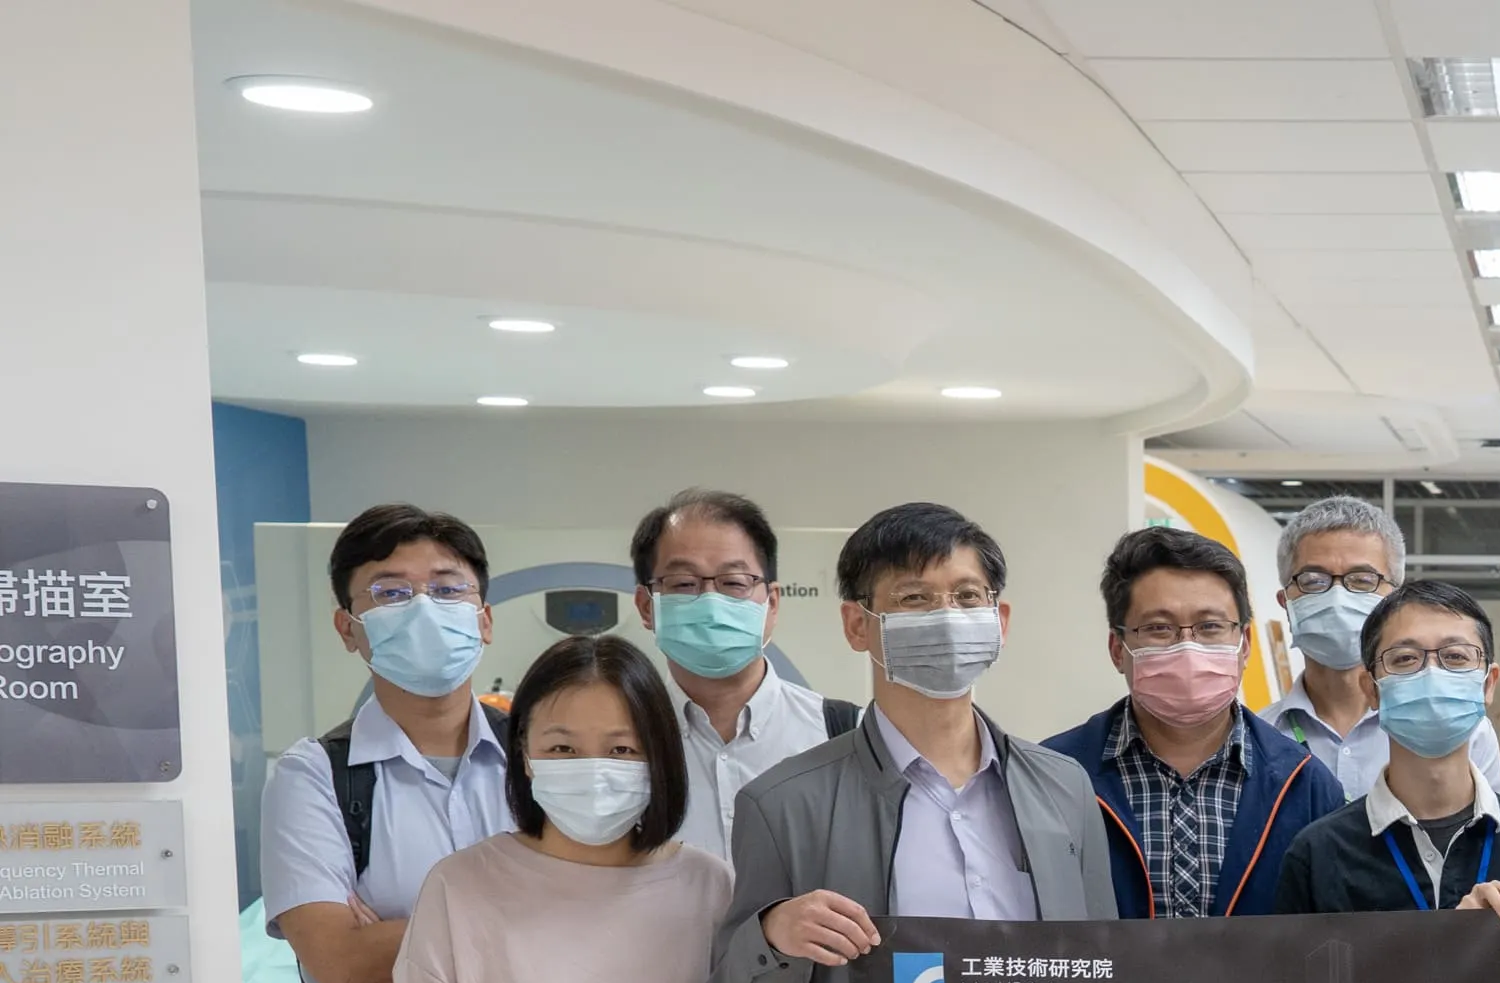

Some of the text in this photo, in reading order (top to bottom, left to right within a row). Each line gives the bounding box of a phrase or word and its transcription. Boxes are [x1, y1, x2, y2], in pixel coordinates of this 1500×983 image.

[0, 640, 125, 670] ography
[72, 861, 144, 877] Thermal
[0, 883, 146, 900] Ablation System
[961, 956, 1113, 979] 工業技術研究院
